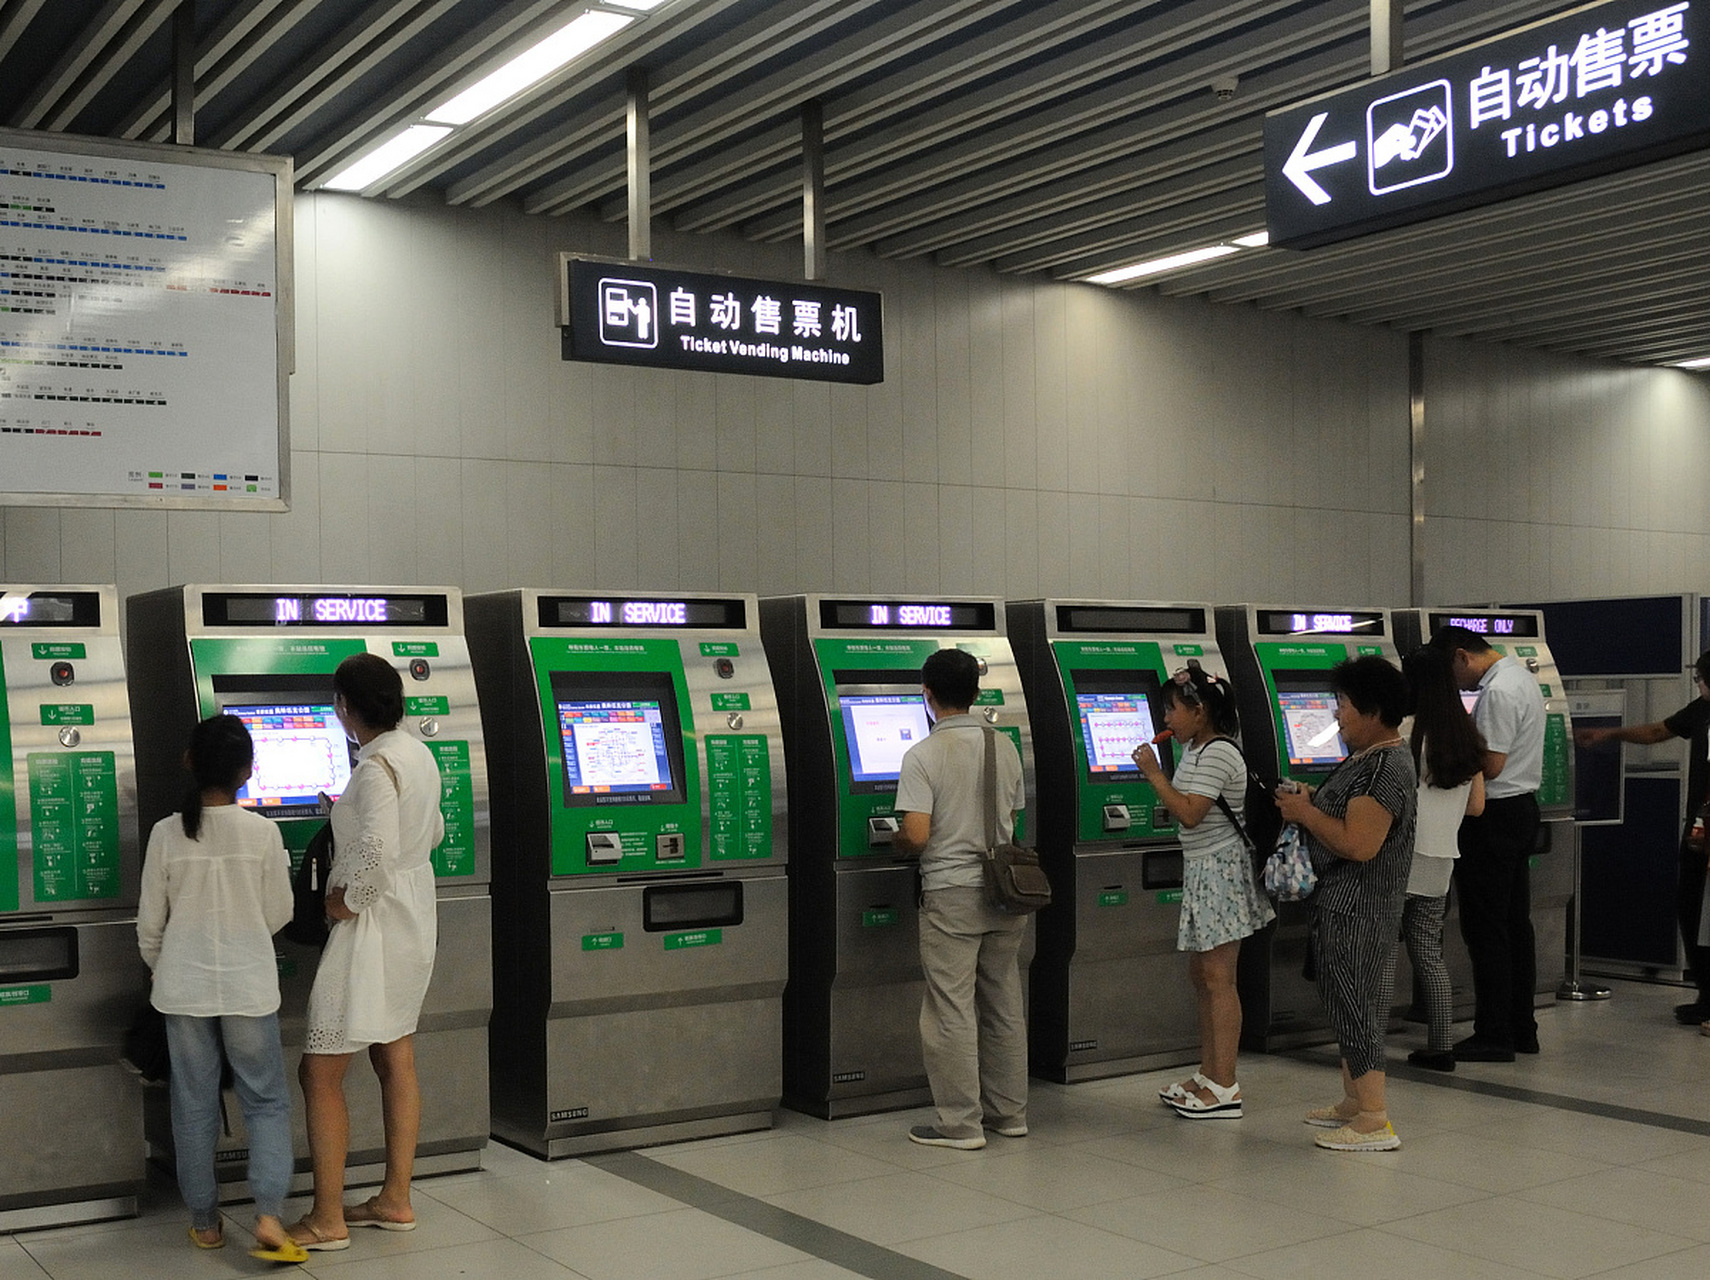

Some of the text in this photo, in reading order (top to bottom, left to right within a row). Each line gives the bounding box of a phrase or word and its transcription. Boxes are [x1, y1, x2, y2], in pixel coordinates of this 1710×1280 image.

[1469, 2, 1690, 130] 自动售票
[1501, 96, 1654, 158] Tickets
[670, 287, 862, 343] 自动售票机
[680, 335, 850, 365] Ticket Vending Machine
[277, 599, 387, 621] IN SERVICE
[591, 602, 686, 624] IN SERVICE
[871, 605, 951, 626] IN SERVICE
[1293, 614, 1352, 632] IN SERVICE
[1494, 619, 1514, 633] ONLY
[551, 1108, 588, 1120] SAMSUNG
